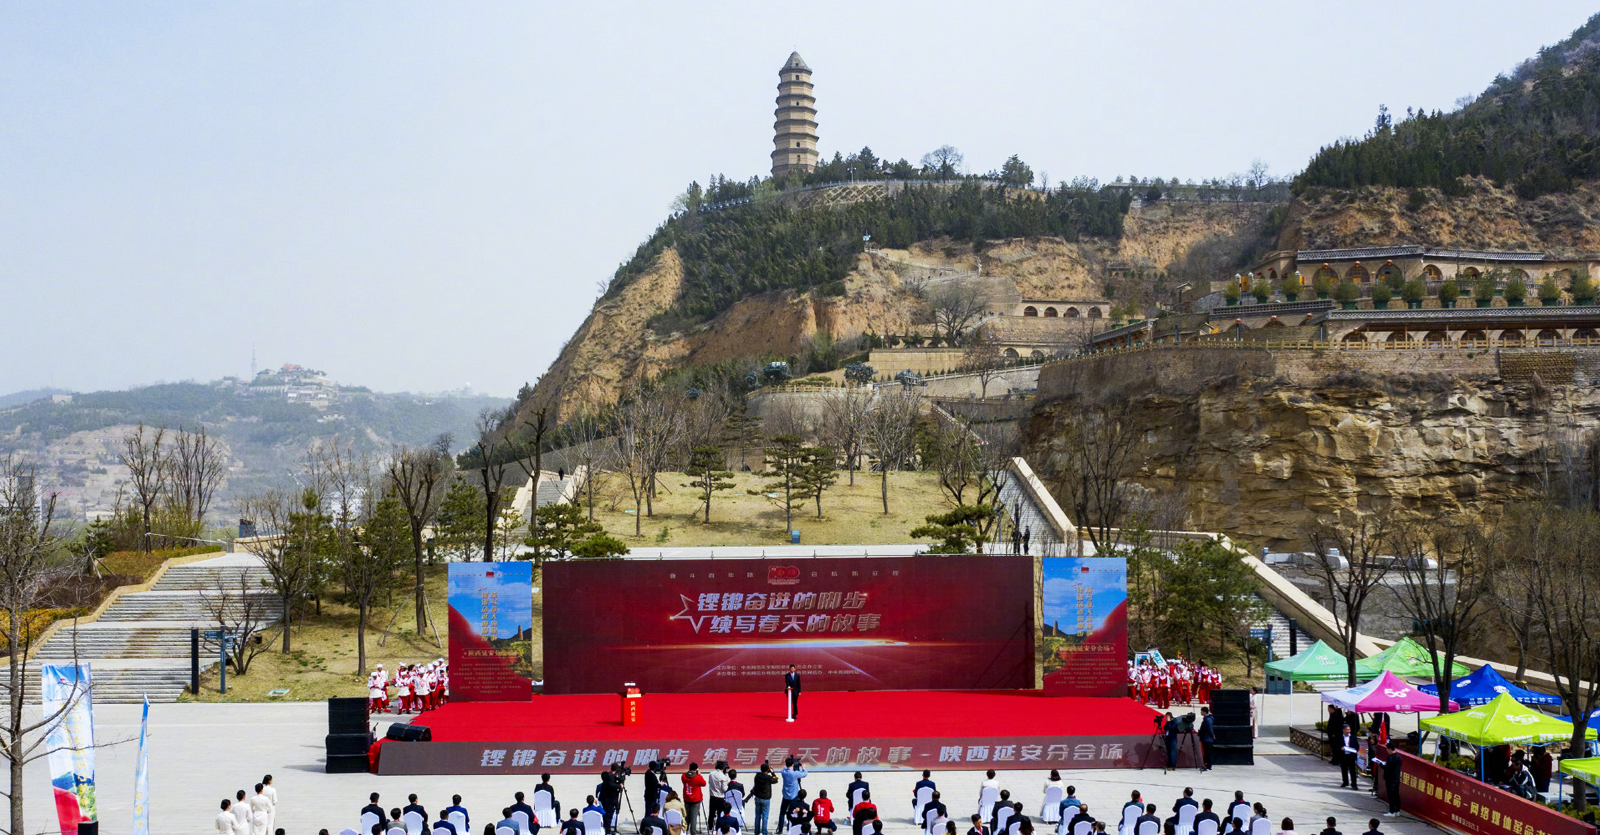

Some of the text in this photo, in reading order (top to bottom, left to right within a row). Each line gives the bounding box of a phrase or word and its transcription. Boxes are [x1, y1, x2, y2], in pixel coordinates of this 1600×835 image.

[697, 591, 868, 611] 铿锵奋进的脚步
[709, 613, 882, 634] 续写春天的故事
[480, 748, 690, 767] 铿锵奋进的脚步
